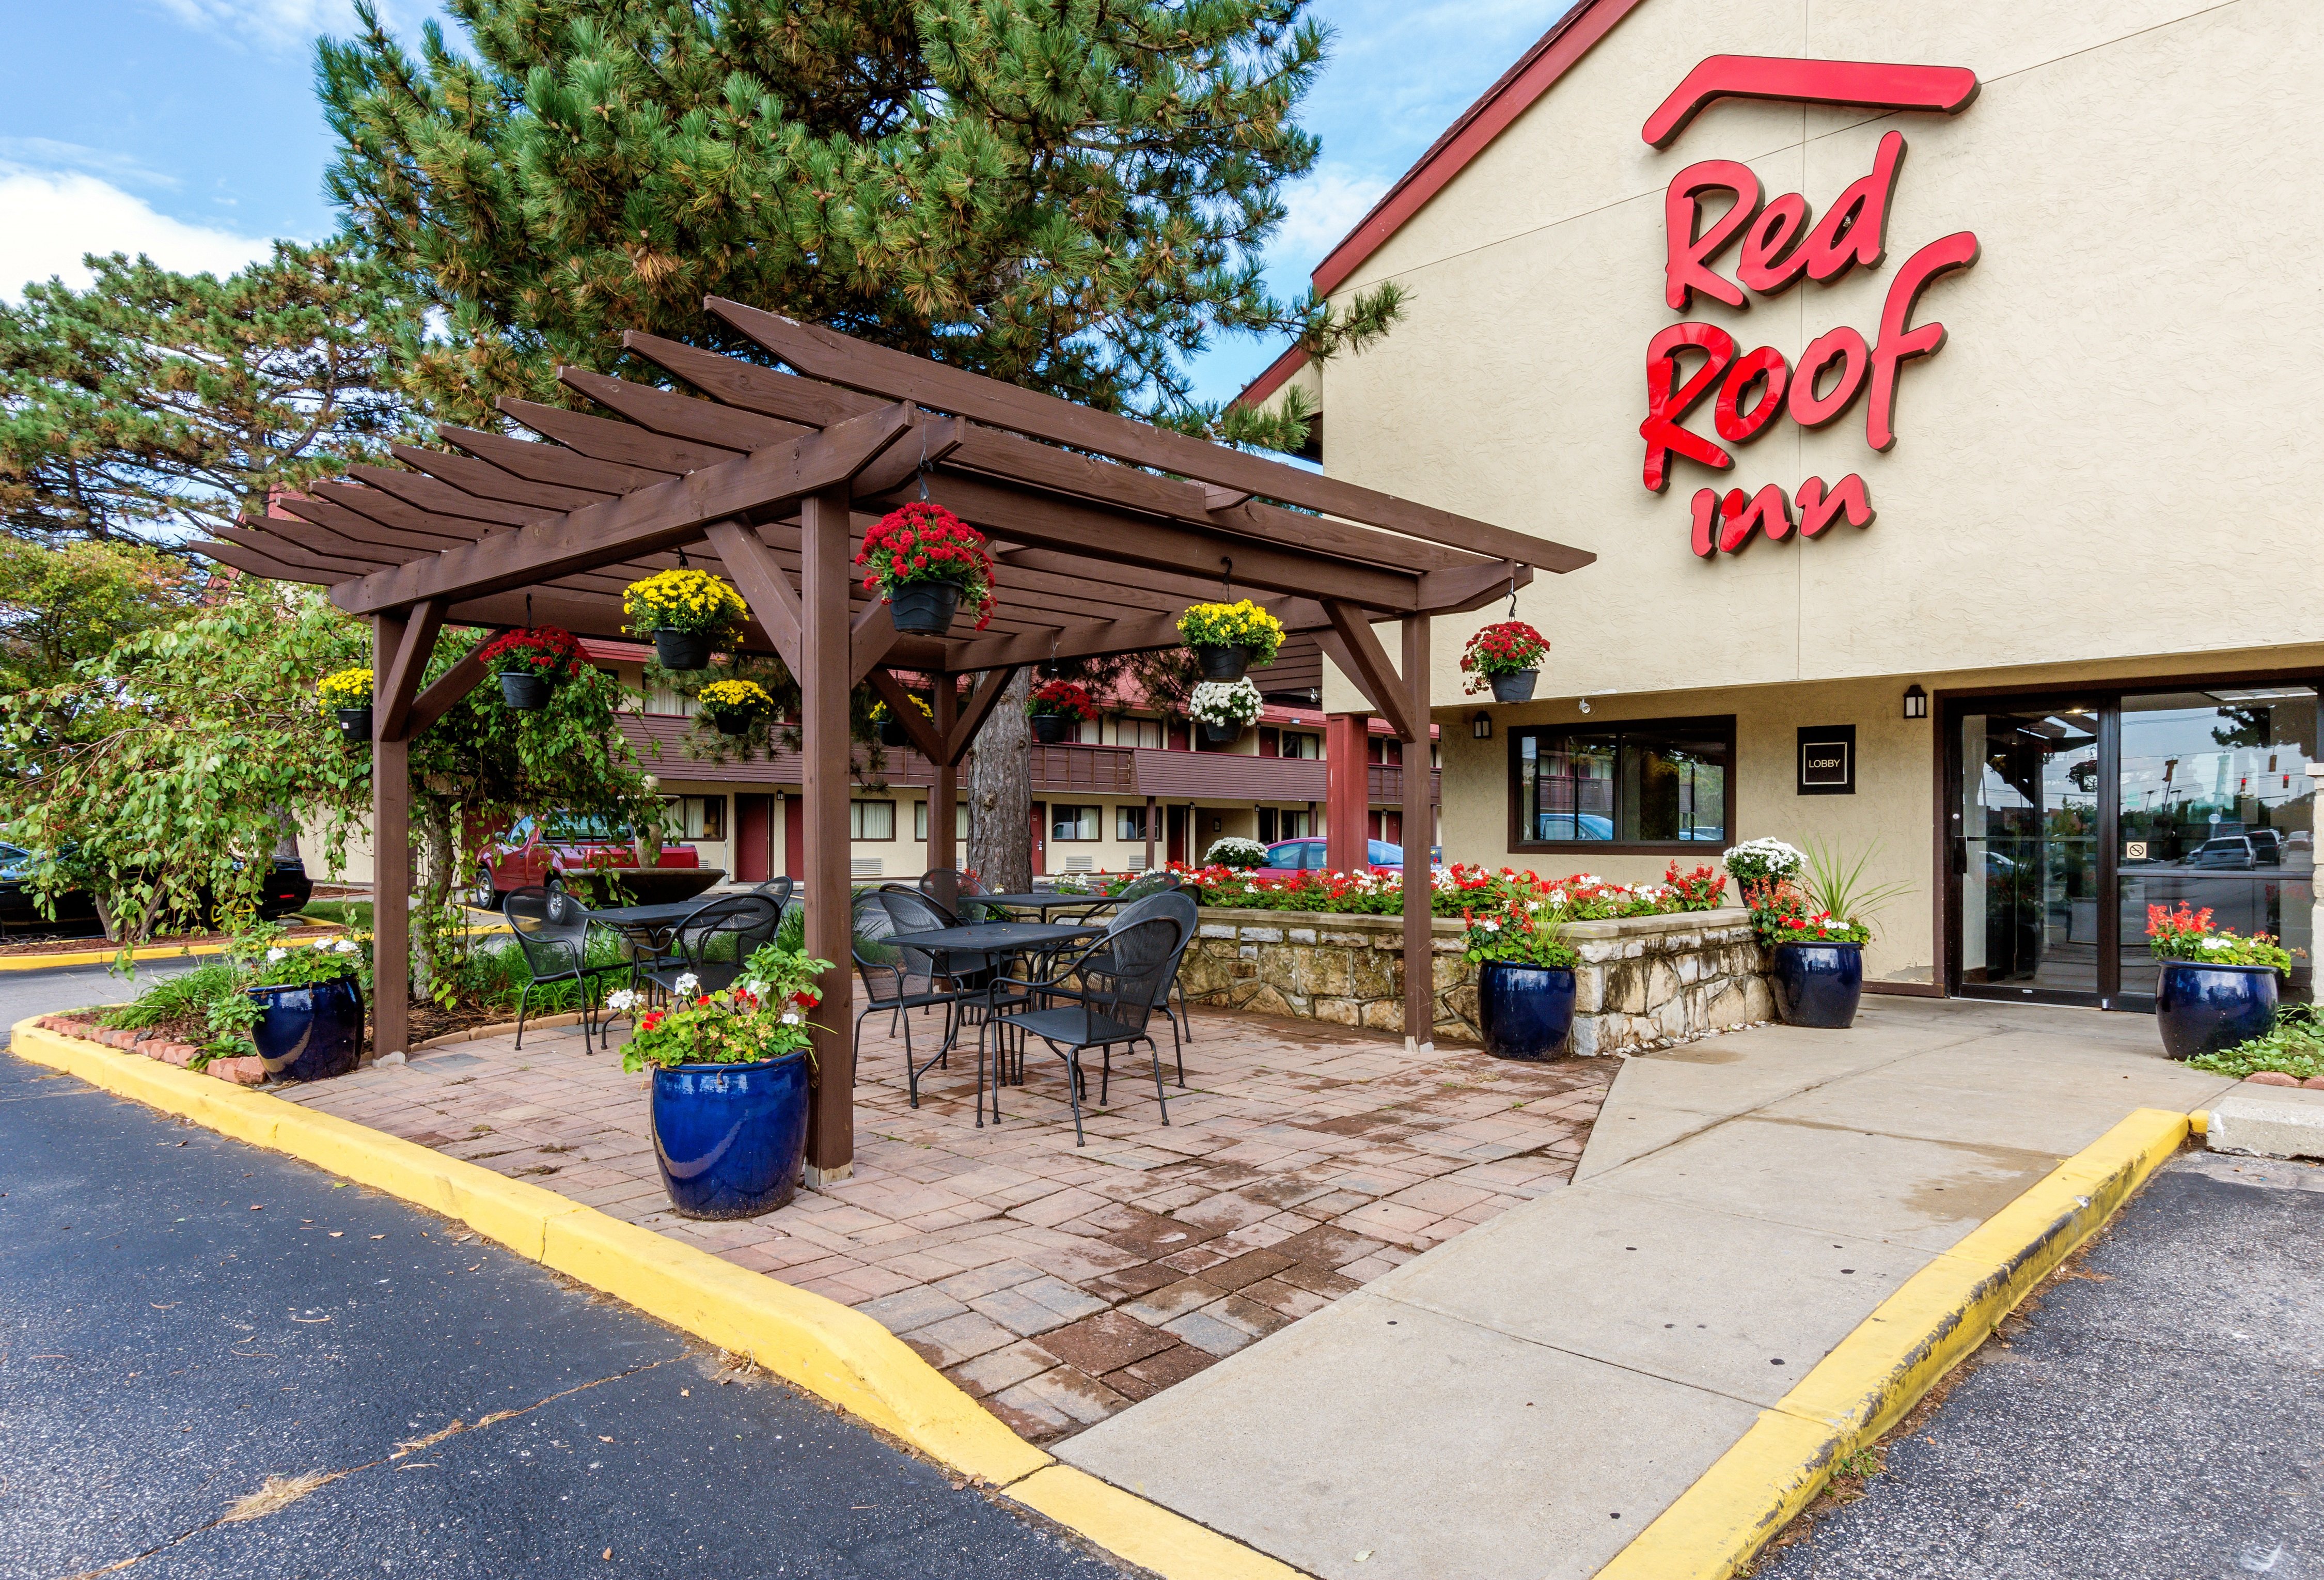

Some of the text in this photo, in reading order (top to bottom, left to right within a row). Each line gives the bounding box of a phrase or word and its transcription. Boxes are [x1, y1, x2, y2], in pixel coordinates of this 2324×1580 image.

[1666, 131, 1908, 311] Red
[1640, 231, 1982, 494] Roof
[1809, 759, 1841, 768] LOBBY
